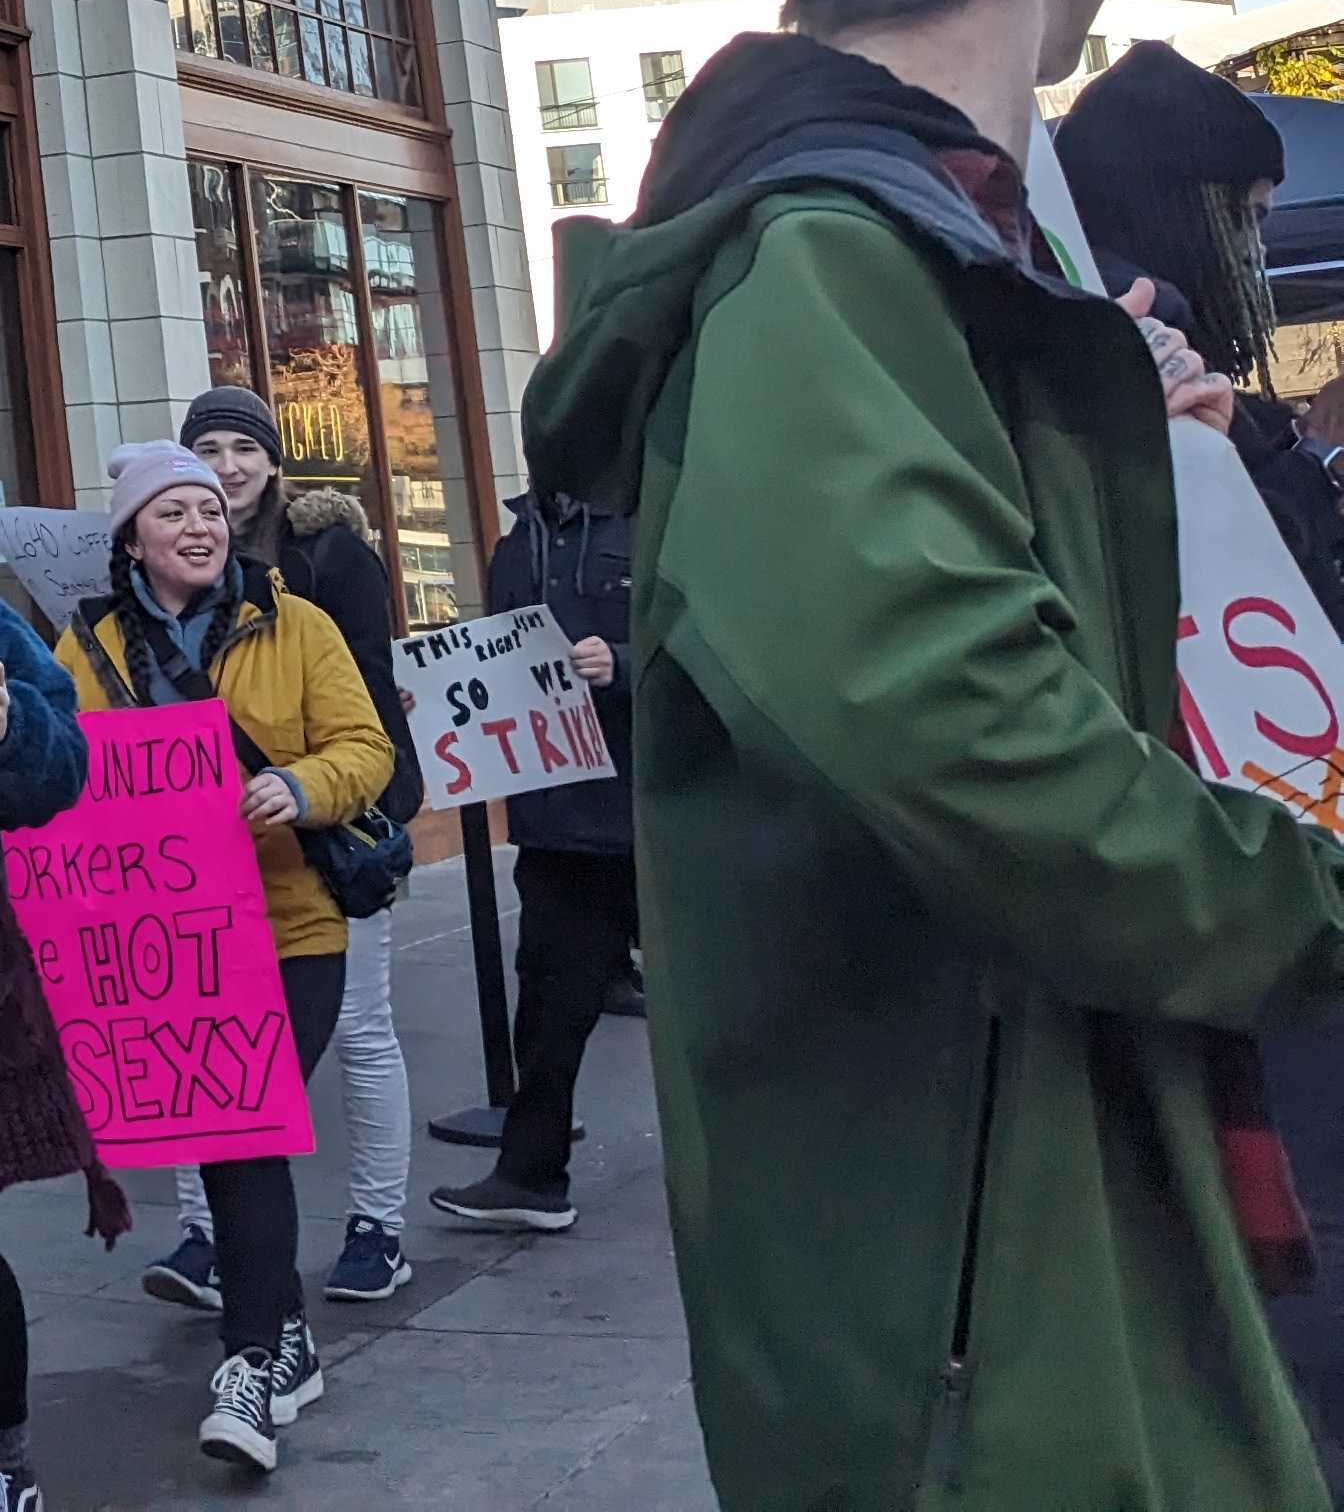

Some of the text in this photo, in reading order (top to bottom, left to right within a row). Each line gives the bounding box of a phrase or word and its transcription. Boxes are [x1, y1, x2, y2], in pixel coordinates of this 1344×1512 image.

[278, 401, 343, 462] ICKED
[403, 626, 472, 668] THIS
[474, 629, 522, 662] RIGHT
[446, 659, 573, 727] SO WE
[88, 730, 223, 804] UNION
[3, 833, 197, 901] ORKERS
[78, 905, 233, 1007] HOT
[58, 1010, 285, 1133] SEXY
